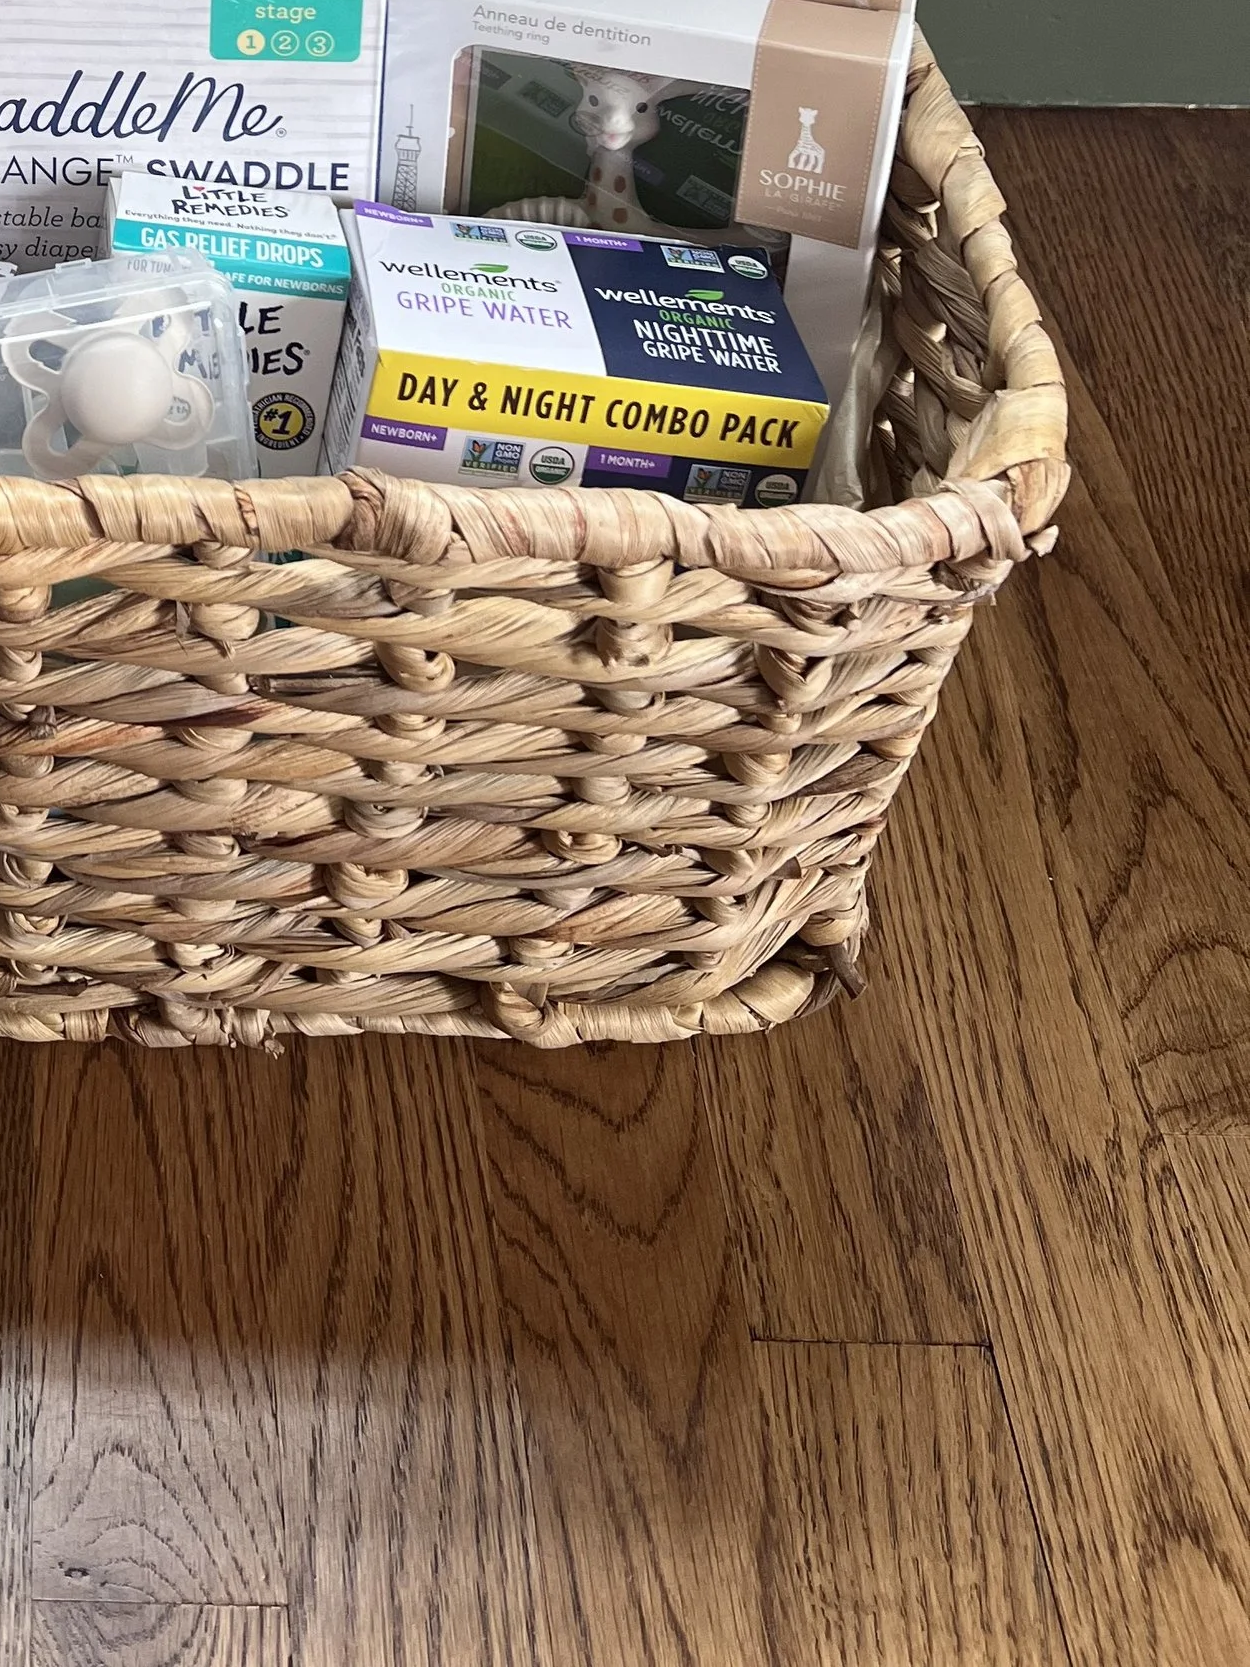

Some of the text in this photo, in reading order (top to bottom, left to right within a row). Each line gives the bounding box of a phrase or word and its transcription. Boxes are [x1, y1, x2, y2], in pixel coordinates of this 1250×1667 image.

[255, 3, 317, 24] stage
[472, 20, 551, 45] Teething ring
[473, 4, 652, 46] Anneau de dentition
[146, 158, 349, 191] SWADDLE
[758, 169, 848, 202] SOPHIE
[765, 188, 782, 198] LA
[171, 199, 287, 218] REMEDIES
[363, 207, 424, 224] NEWBORN+
[125, 209, 180, 223] Everything
[182, 216, 205, 226] they
[237, 223, 277, 234] Nothing
[279, 228, 303, 237] they
[141, 227, 324, 268] GAS RELIEF DROPS
[583, 236, 628, 247] MONTH+
[127, 258, 147, 273] FOR
[247, 273, 272, 286] FOR
[274, 277, 345, 295] NEWBORNS
[379, 260, 558, 293] wellements
[441, 282, 517, 302] ORGANIC
[397, 291, 473, 317] GRIPE
[482, 300, 573, 330] WATER
[594, 287, 776, 324] wellements
[659, 309, 735, 330] ORGANIC
[633, 319, 778, 357] NIGHTTIME
[643, 340, 782, 374] GRIPE WATER
[397, 372, 801, 449] DAY & NIGHT COMBO PACK
[263, 408, 292, 435] #1
[370, 423, 438, 442] NEWBORN+
[495, 450, 521, 460] GMO
[496, 443, 522, 452] NON
[464, 460, 517, 472] VERIFIED
[540, 455, 566, 465] USDA
[600, 453, 655, 468] 1 MONTH+
